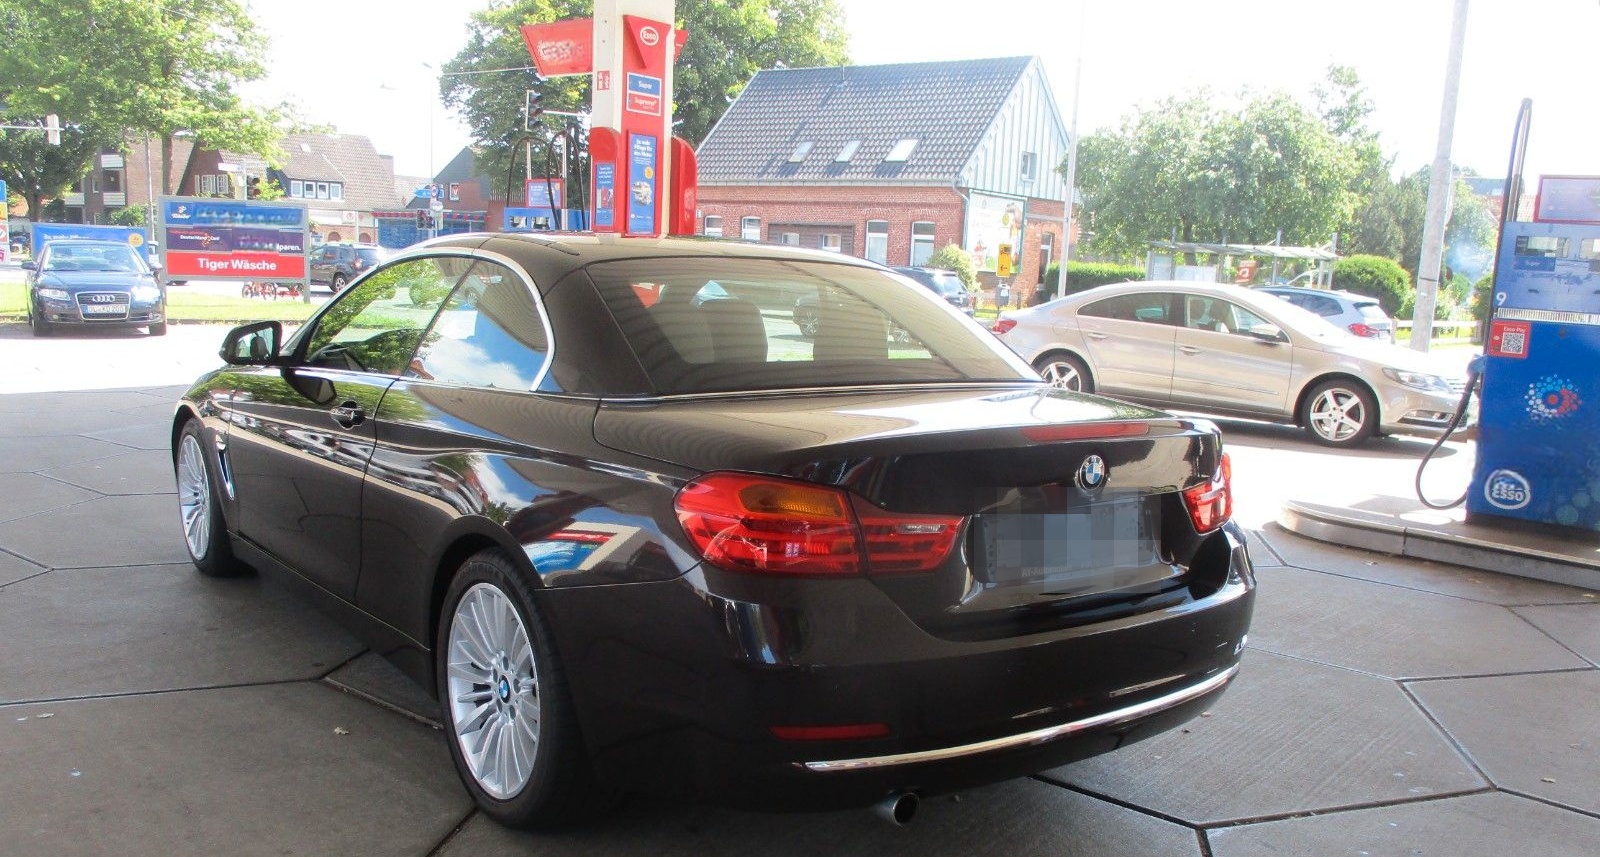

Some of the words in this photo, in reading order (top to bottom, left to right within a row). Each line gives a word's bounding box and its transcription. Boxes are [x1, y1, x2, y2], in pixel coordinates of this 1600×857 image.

[197, 258, 229, 271] Tiger
[230, 258, 277, 271] Wäsche
[1496, 291, 1507, 307] 9
